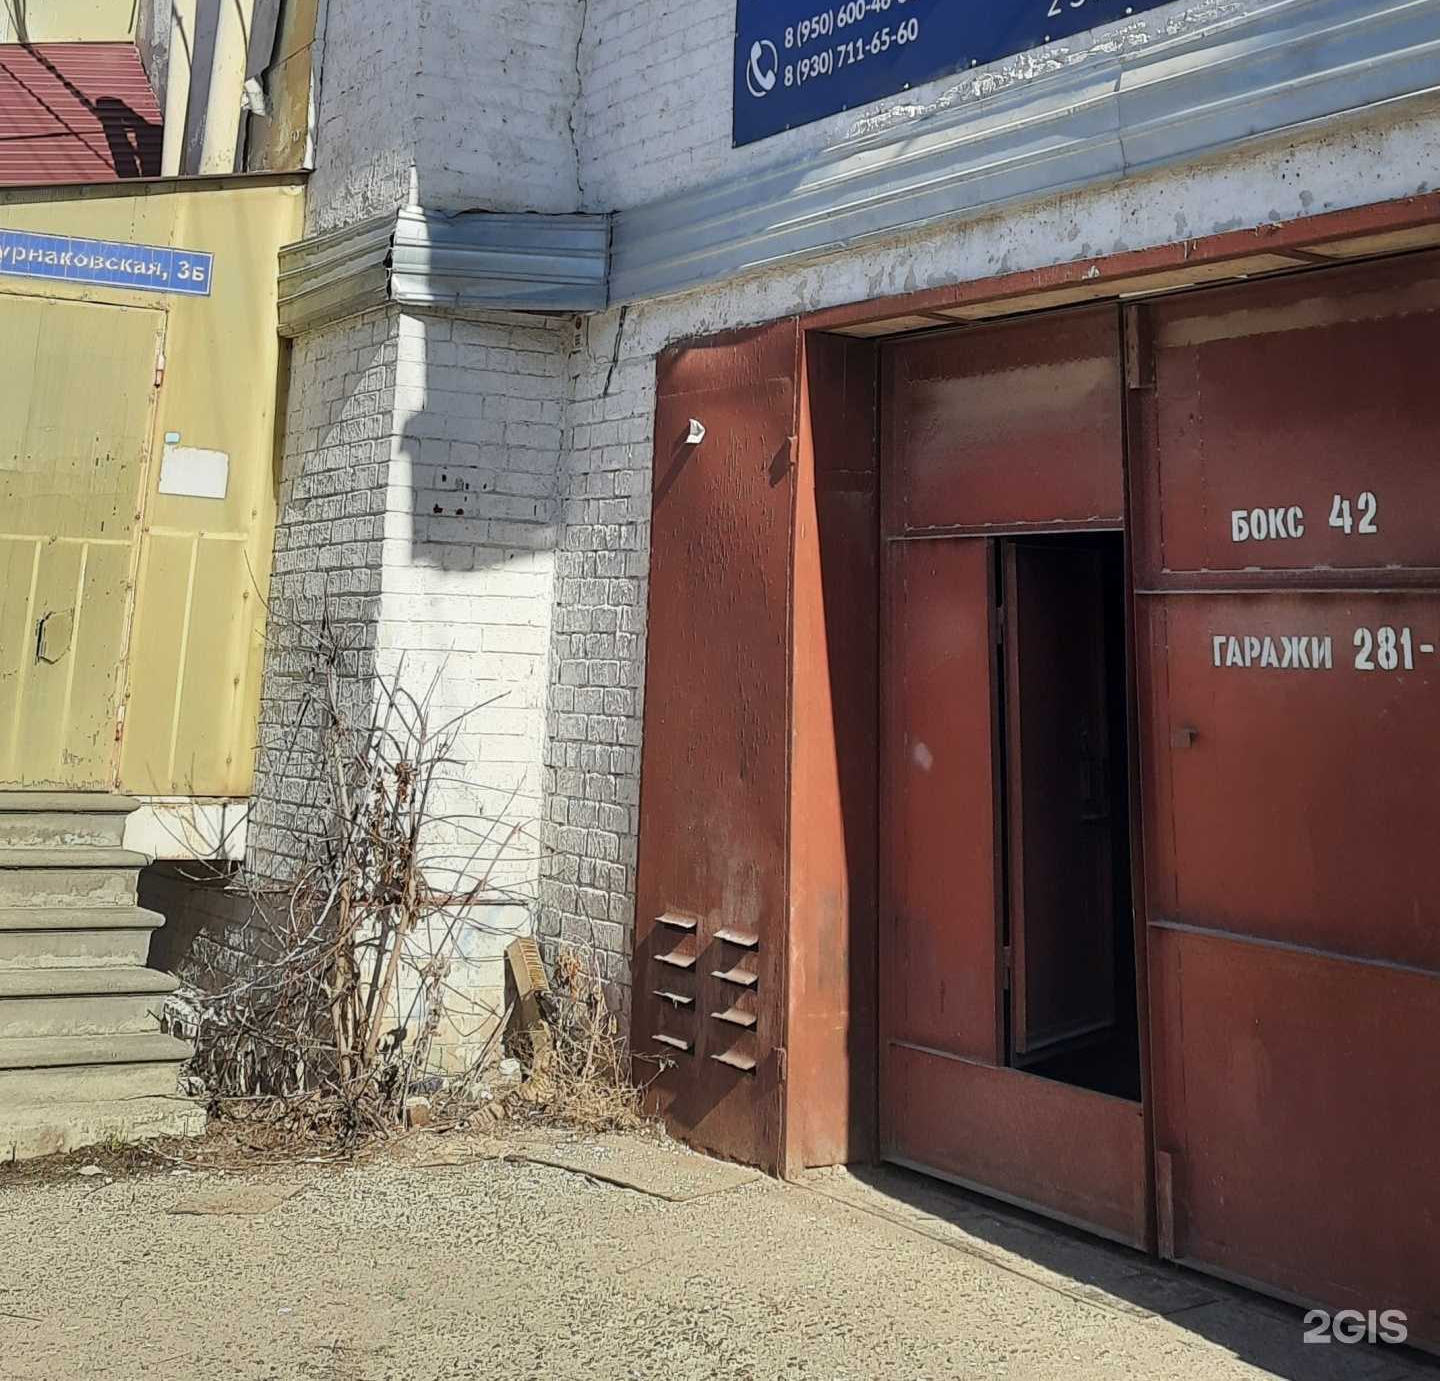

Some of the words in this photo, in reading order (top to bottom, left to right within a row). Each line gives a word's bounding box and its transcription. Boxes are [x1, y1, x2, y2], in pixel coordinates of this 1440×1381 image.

[784, 27, 794, 49] 8
[797, 9, 834, 47] (950)
[783, 65, 793, 87] 8
[797, 48, 834, 85] (930)
[837, 18, 919, 67] 711-65-60
[1231, 506, 1304, 542] БОКС
[1328, 491, 1378, 534] 42
[1213, 635, 1333, 669] ГАРАЖИ
